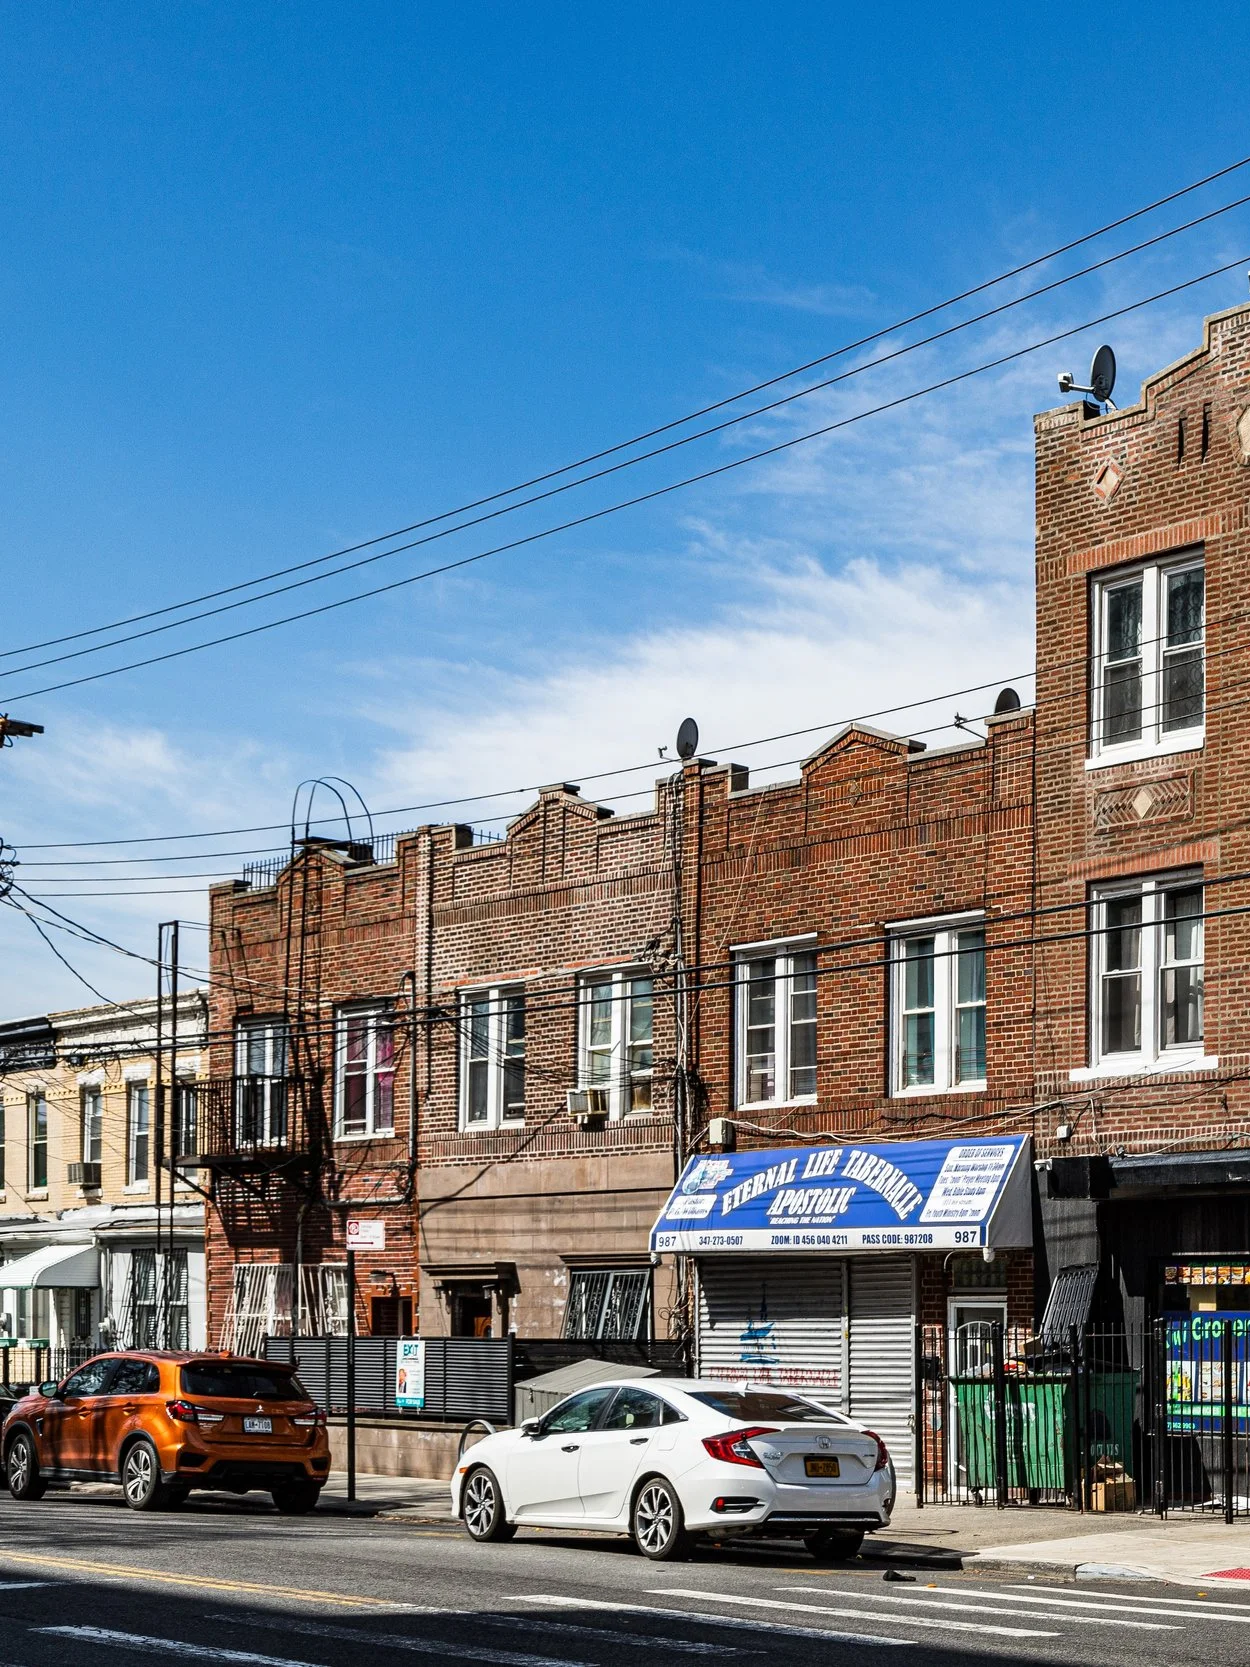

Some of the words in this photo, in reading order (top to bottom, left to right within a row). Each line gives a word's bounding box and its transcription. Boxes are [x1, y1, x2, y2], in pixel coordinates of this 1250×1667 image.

[958, 1148, 975, 1158] ORDER
[974, 1148, 983, 1157] OF
[981, 1147, 1005, 1157] SERVICES
[970, 1163, 988, 1172] Worship
[974, 1174, 991, 1183] Meeting
[721, 1158, 798, 1216] ETERNAL
[801, 1149, 844, 1180] LIFE
[841, 1150, 923, 1221] TABERNACLE
[952, 1187, 964, 1196] Bible
[963, 1187, 976, 1196] Study
[766, 1187, 857, 1215] APOSTOLIC
[943, 1209, 960, 1217] Ministry
[658, 1236, 676, 1247] 987
[699, 1236, 743, 1246] 347-273-0507
[771, 1235, 792, 1244] ZOOM:
[793, 1235, 800, 1244] ID
[802, 1235, 815, 1244] 456
[817, 1235, 830, 1244] 040
[832, 1235, 848, 1244] 4211
[862, 1234, 882, 1244] PASS
[882, 1234, 903, 1244] CODE:
[904, 1233, 933, 1244] 987208
[955, 1231, 976, 1243] 987
[404, 1344, 418, 1356] EXIT
